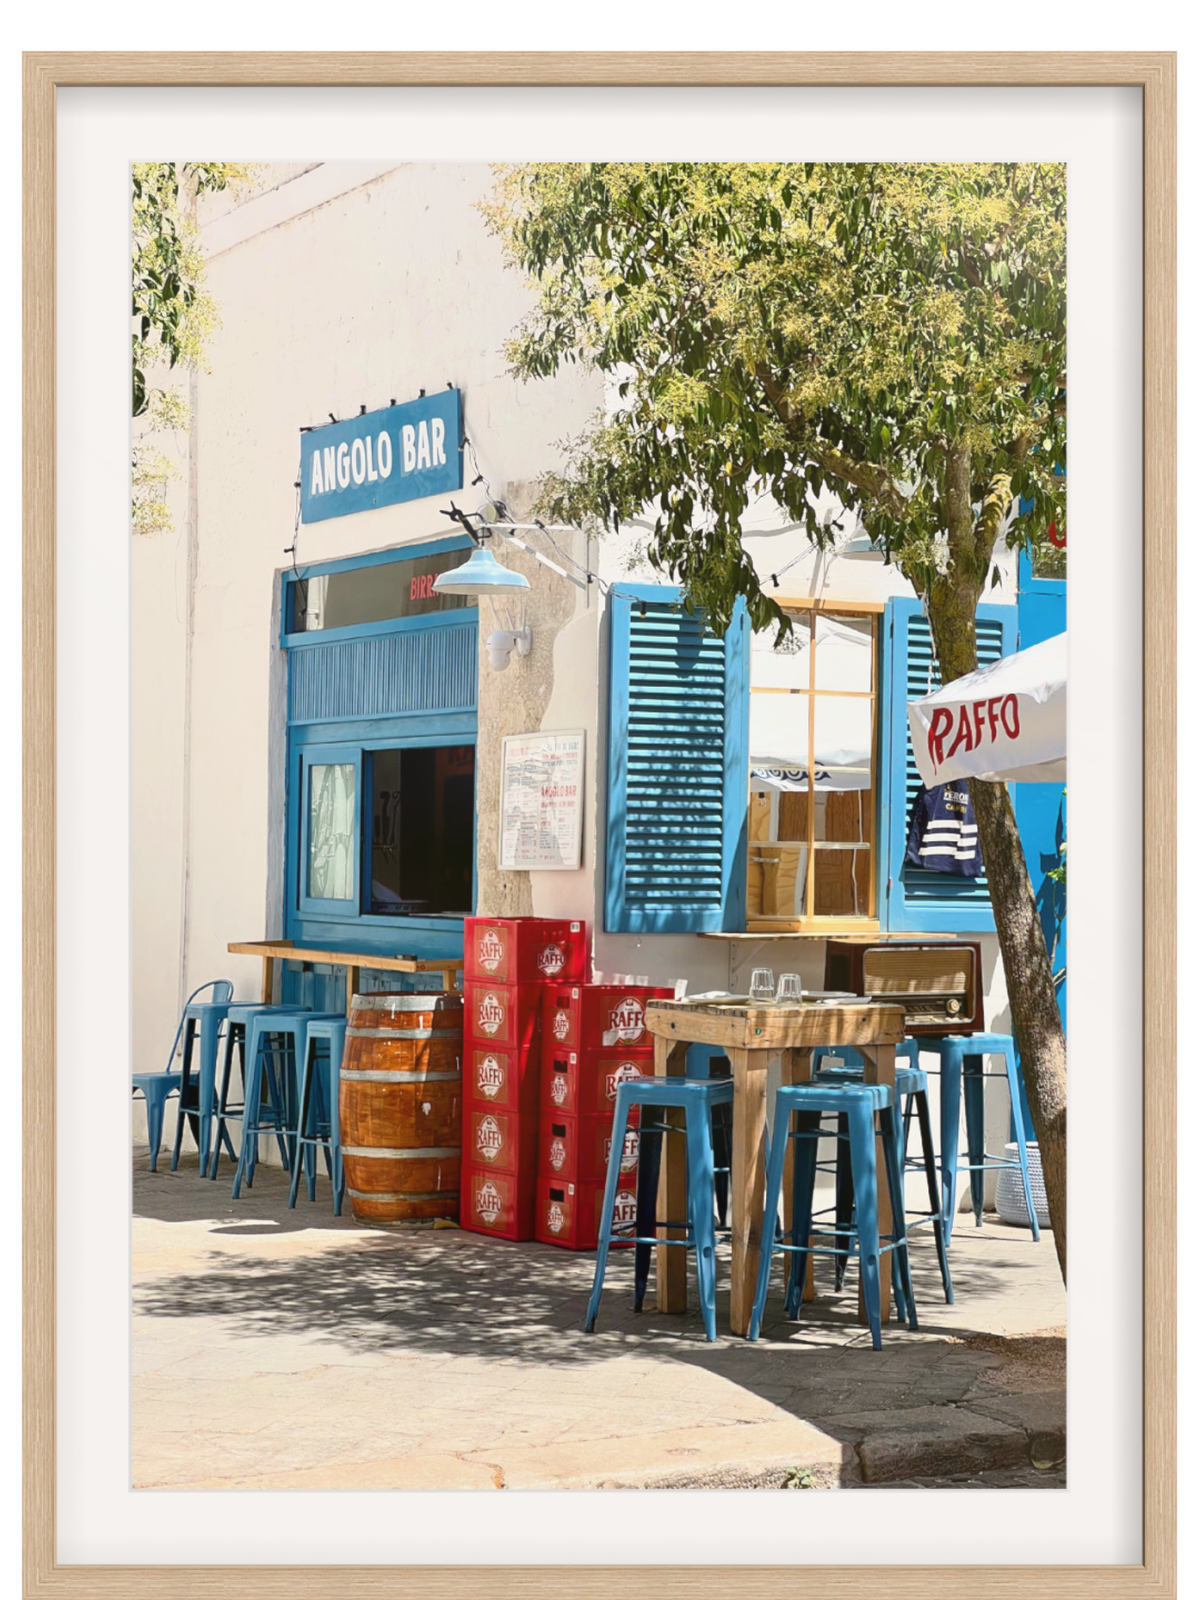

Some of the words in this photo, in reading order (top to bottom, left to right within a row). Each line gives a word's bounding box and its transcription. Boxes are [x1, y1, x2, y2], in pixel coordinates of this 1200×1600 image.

[311, 431, 393, 495] ANGOLO
[402, 418, 446, 473] BAR
[928, 693, 1020, 776] RAFFO
[479, 941, 504, 960] RAFFO
[538, 953, 565, 966] RAFFO
[479, 1004, 504, 1022] RAFFO
[478, 1066, 503, 1085] RAFFO
[477, 1127, 502, 1147] RAFFO
[476, 1191, 502, 1211] RAFFO
